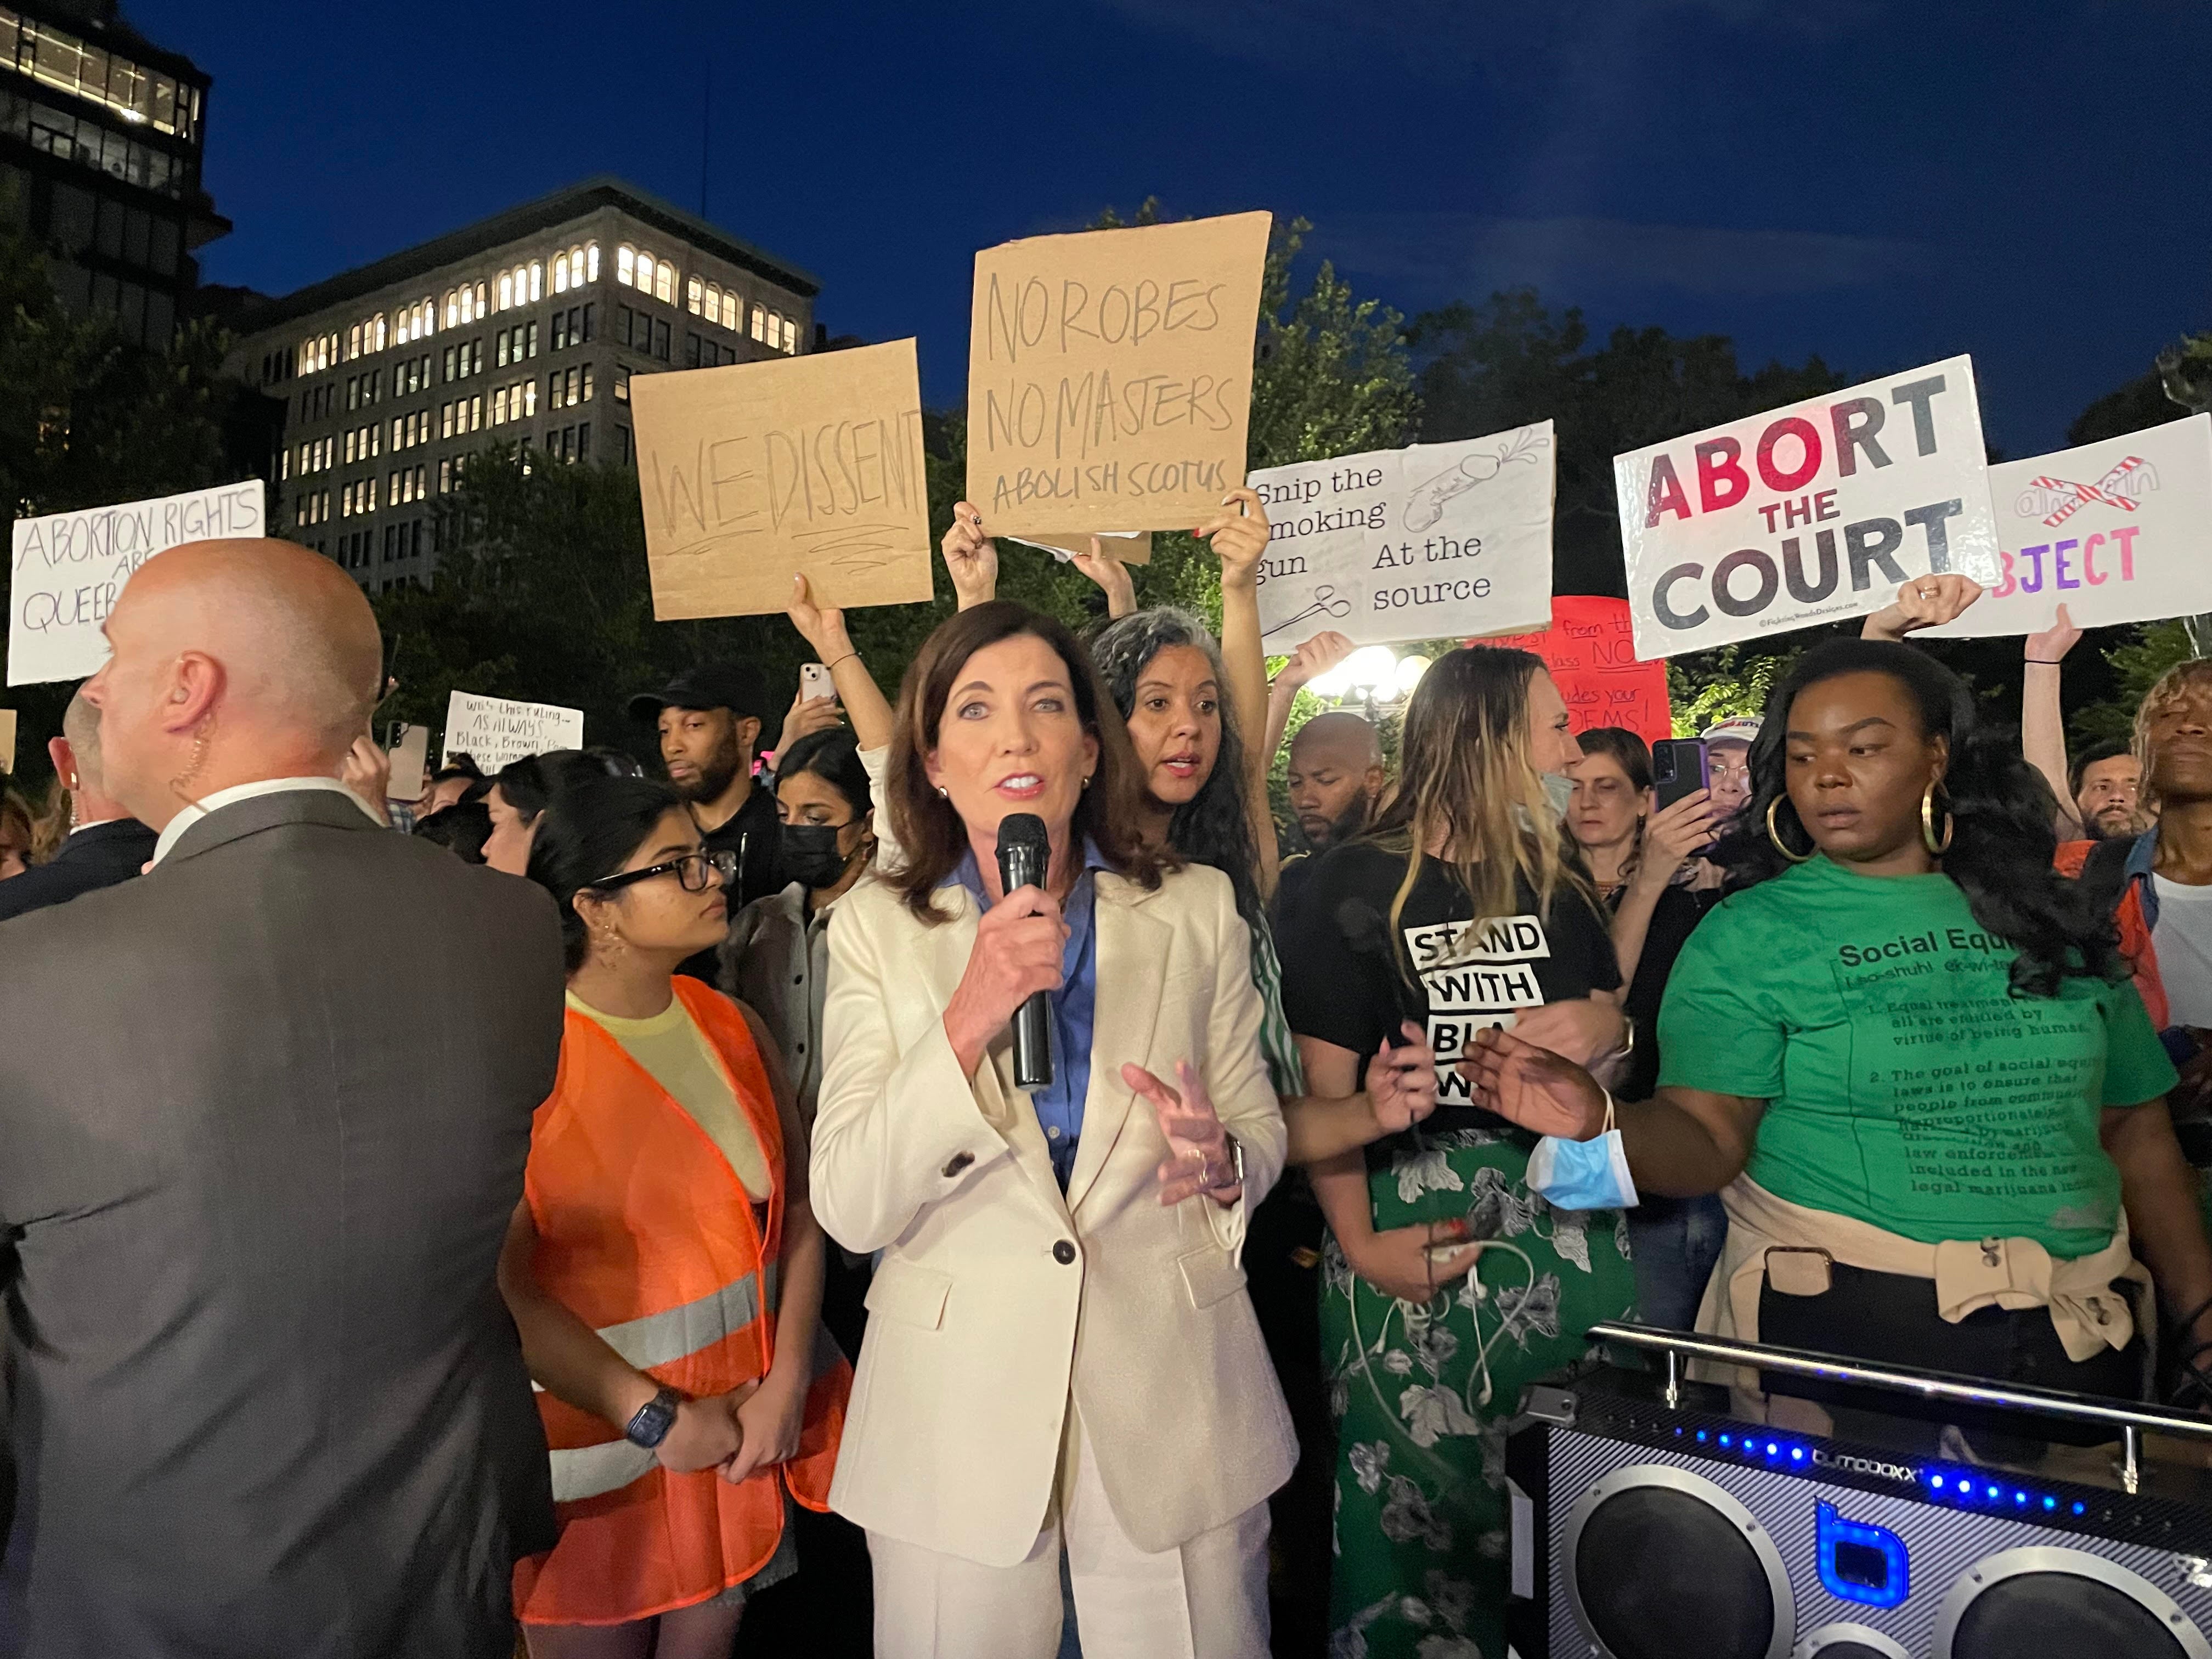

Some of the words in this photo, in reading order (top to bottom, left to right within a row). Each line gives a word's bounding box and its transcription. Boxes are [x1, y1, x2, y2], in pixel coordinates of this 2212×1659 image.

[989, 272, 1048, 363] NO
[1060, 279, 1227, 354] ROBES
[987, 377, 1045, 452] NO
[1056, 369, 1234, 460] MASTERS
[1646, 374, 1946, 529] ABORT
[652, 437, 759, 538] WE
[764, 408, 922, 535] DISSENT
[994, 461, 1119, 515] ABOLISH
[1127, 459, 1227, 498] SCOTUS
[1255, 478, 1321, 506] Snip
[1331, 467, 1384, 494] the
[1269, 501, 1386, 541] moking
[1758, 488, 1841, 533] THE
[16, 507, 153, 571] ABORTION
[164, 488, 259, 544] RIGHTS
[1372, 541, 1415, 570] At
[1423, 535, 1481, 563] the
[1652, 498, 1963, 630] COURT
[1992, 526, 2140, 599] BJECT
[1373, 577, 1491, 611] source
[1563, 619, 1604, 636] from
[1550, 652, 1581, 668] lass
[1605, 688, 1642, 707] your
[1414, 922, 1541, 962] STAND
[1839, 931, 1939, 967] Social
[1428, 972, 1534, 1002] WITH
[2021, 1009, 2042, 1022] by
[1891, 1069, 1925, 1082] The
[1931, 1062, 1969, 1079] goal
[1976, 1060, 1993, 1073] of
[1999, 1057, 2051, 1072] social
[1894, 1085, 1933, 1098] laws
[1939, 1081, 1954, 1093] is
[1960, 1081, 1976, 1091] to
[1983, 1076, 2041, 1089] ensure
[1894, 1099, 1957, 1115] people
[1964, 1096, 2003, 1108] from
[1909, 1163, 1993, 1177] included
[1999, 1166, 2016, 1177] in
[1911, 1180, 1961, 1195] legal
